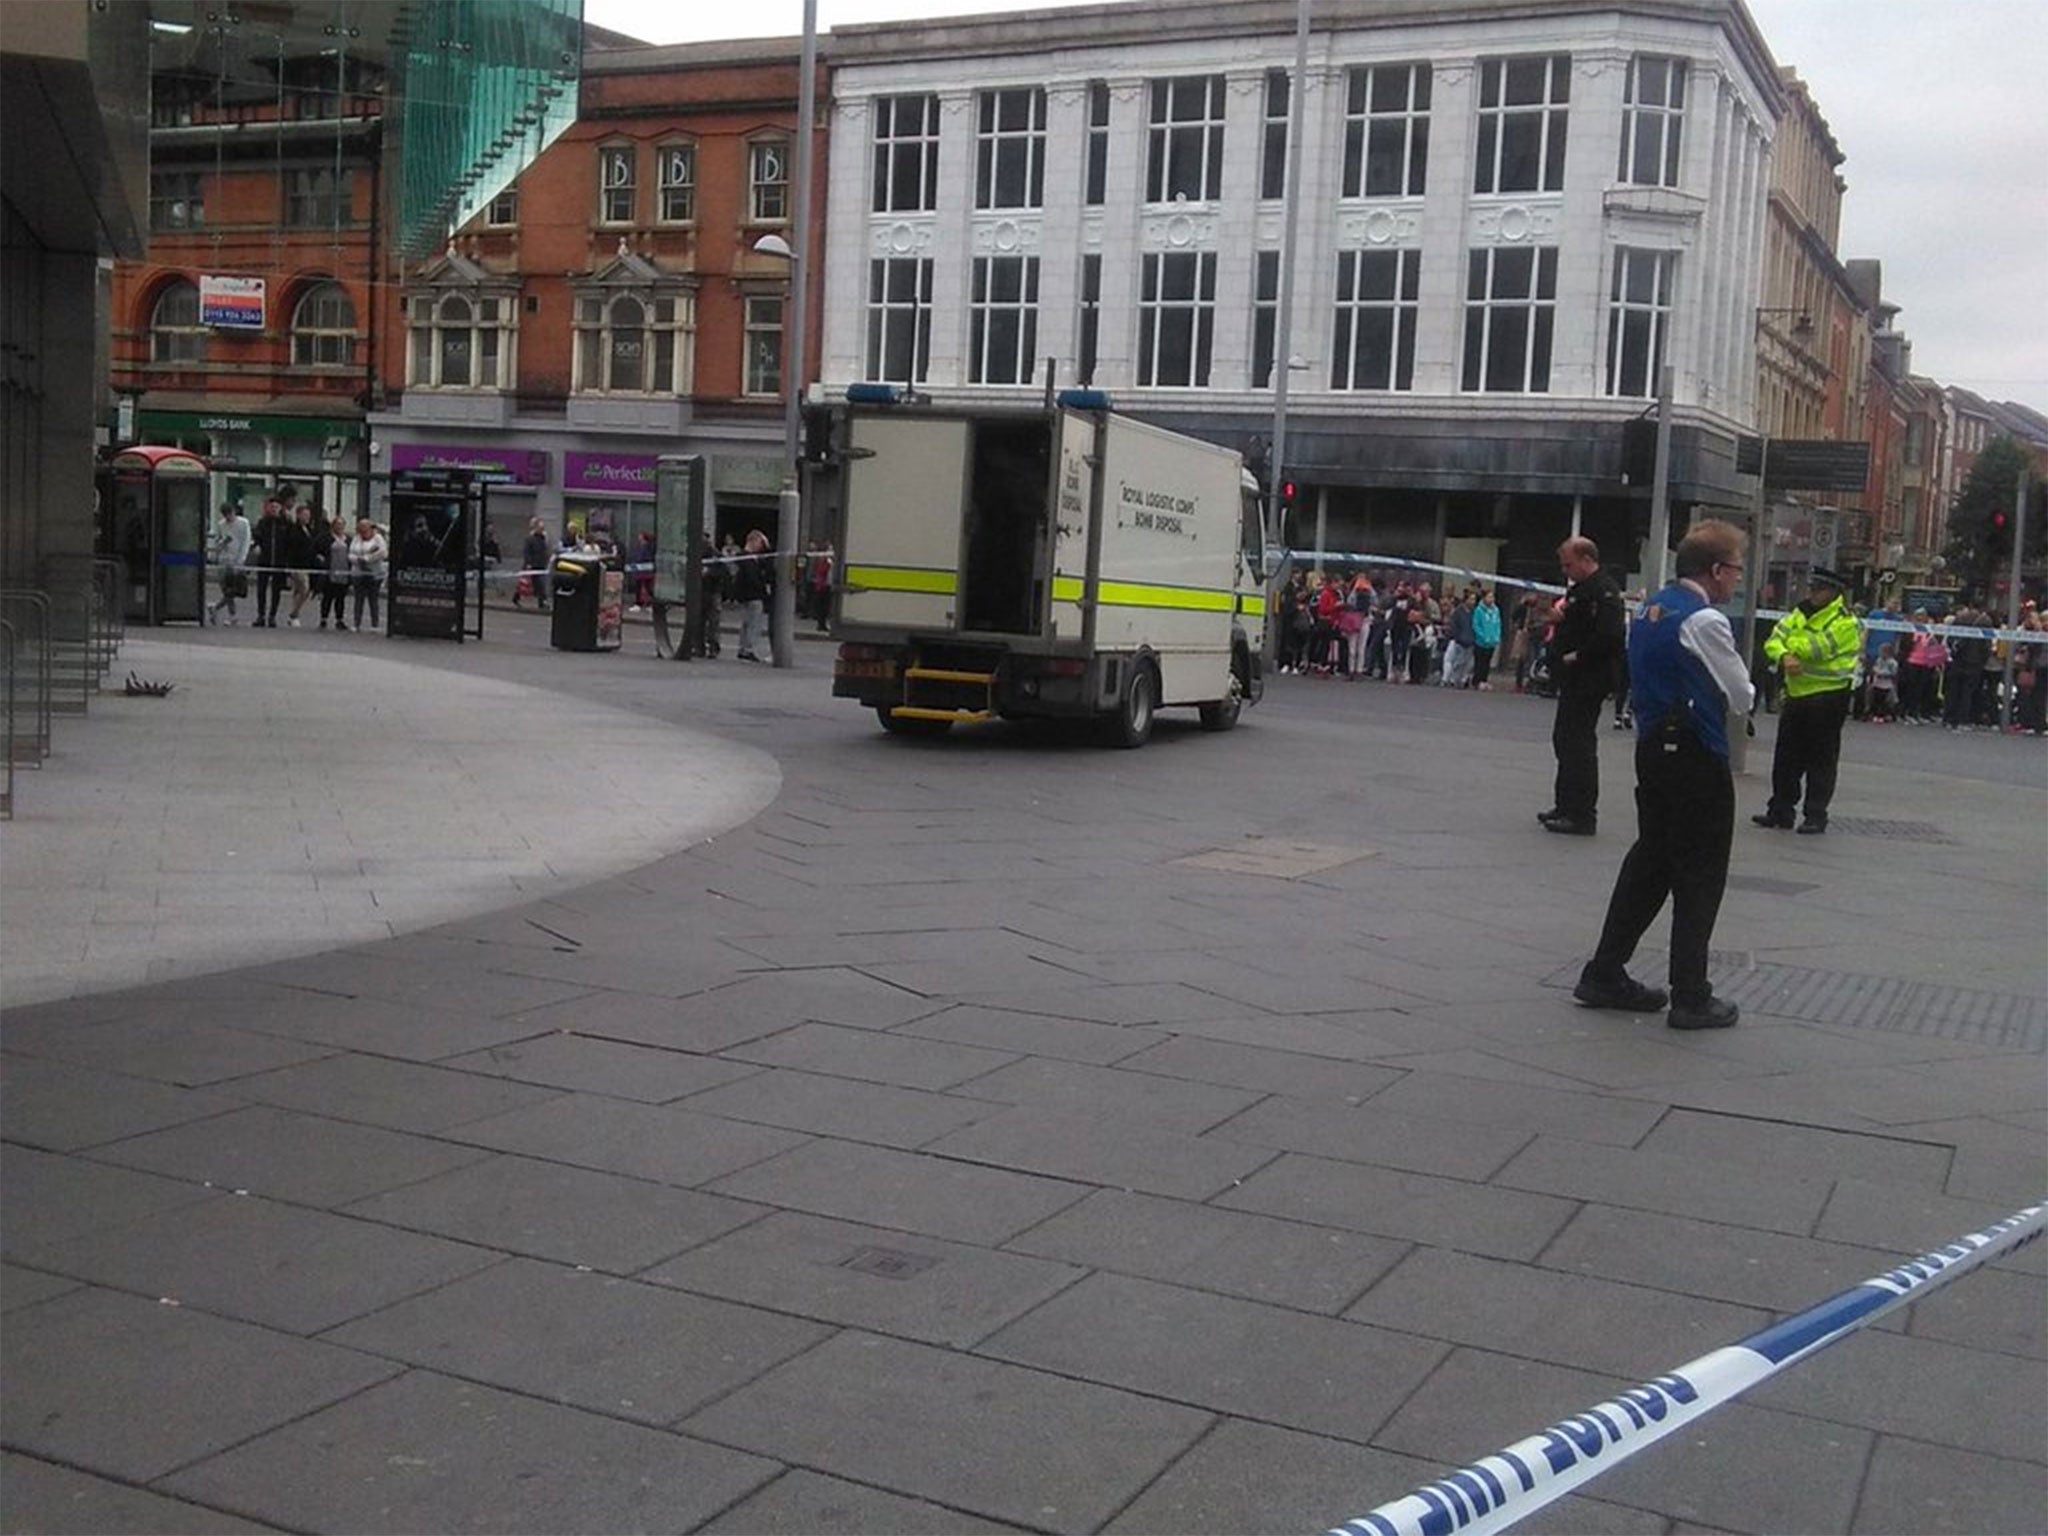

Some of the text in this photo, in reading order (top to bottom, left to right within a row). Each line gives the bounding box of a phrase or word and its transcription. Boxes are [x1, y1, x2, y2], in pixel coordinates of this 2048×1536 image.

[199, 419, 252, 430] LLOYDS BANK
[1122, 486, 1195, 516] ROYAL LOGISTIC CORPS
[1135, 511, 1182, 533] BOMB DISPOSAL
